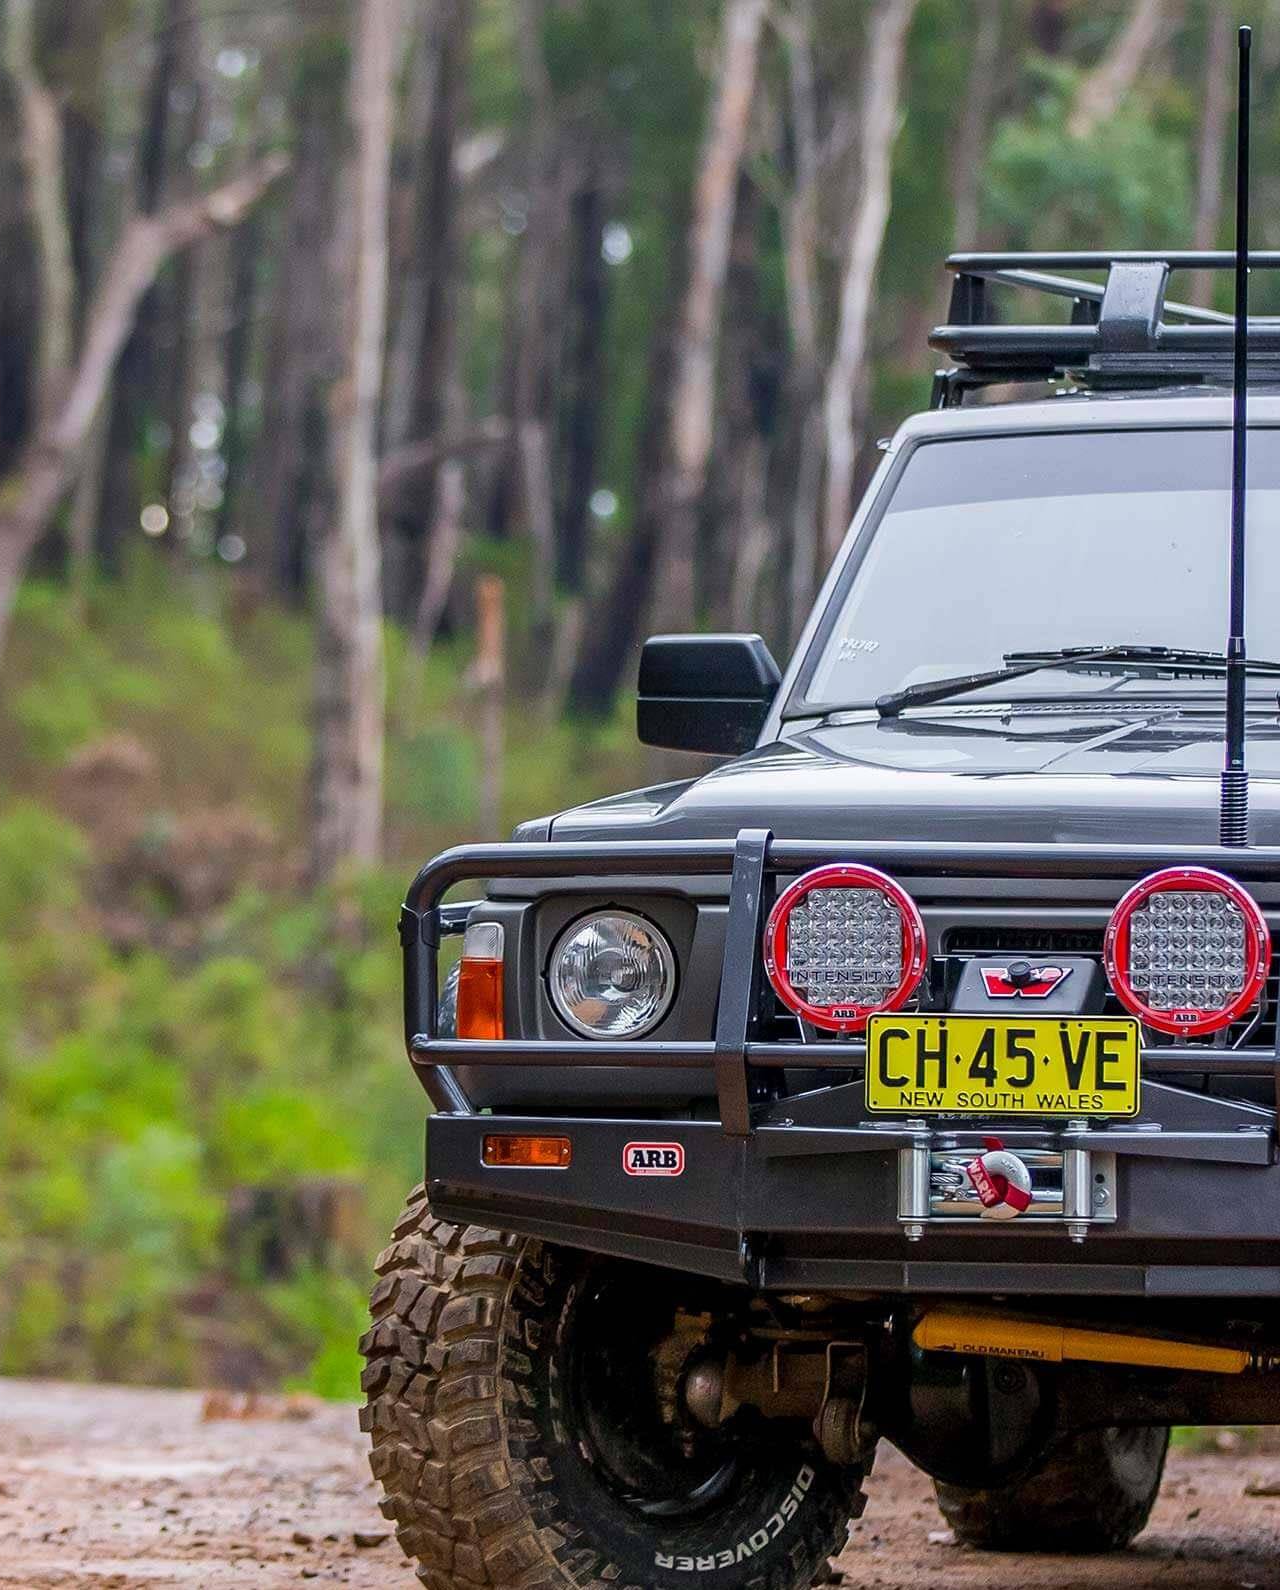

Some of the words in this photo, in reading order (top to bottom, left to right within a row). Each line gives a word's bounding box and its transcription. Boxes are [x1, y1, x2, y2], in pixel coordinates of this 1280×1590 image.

[790, 970, 896, 982] INTENSITY
[1132, 974, 1239, 985] INTENSITY
[833, 1009, 855, 1018] ARB
[1175, 1014, 1198, 1023] ARB
[900, 1091, 944, 1107] NEW
[956, 1092, 1024, 1109] SOUTH
[1036, 1093, 1103, 1110] WALES
[631, 1149, 677, 1168] ARB
[962, 1344, 987, 1353] OLD
[988, 1346, 1016, 1357] MAN
[1017, 1349, 1045, 1359] EMU
[654, 1463, 816, 1572] DISCOVERER
